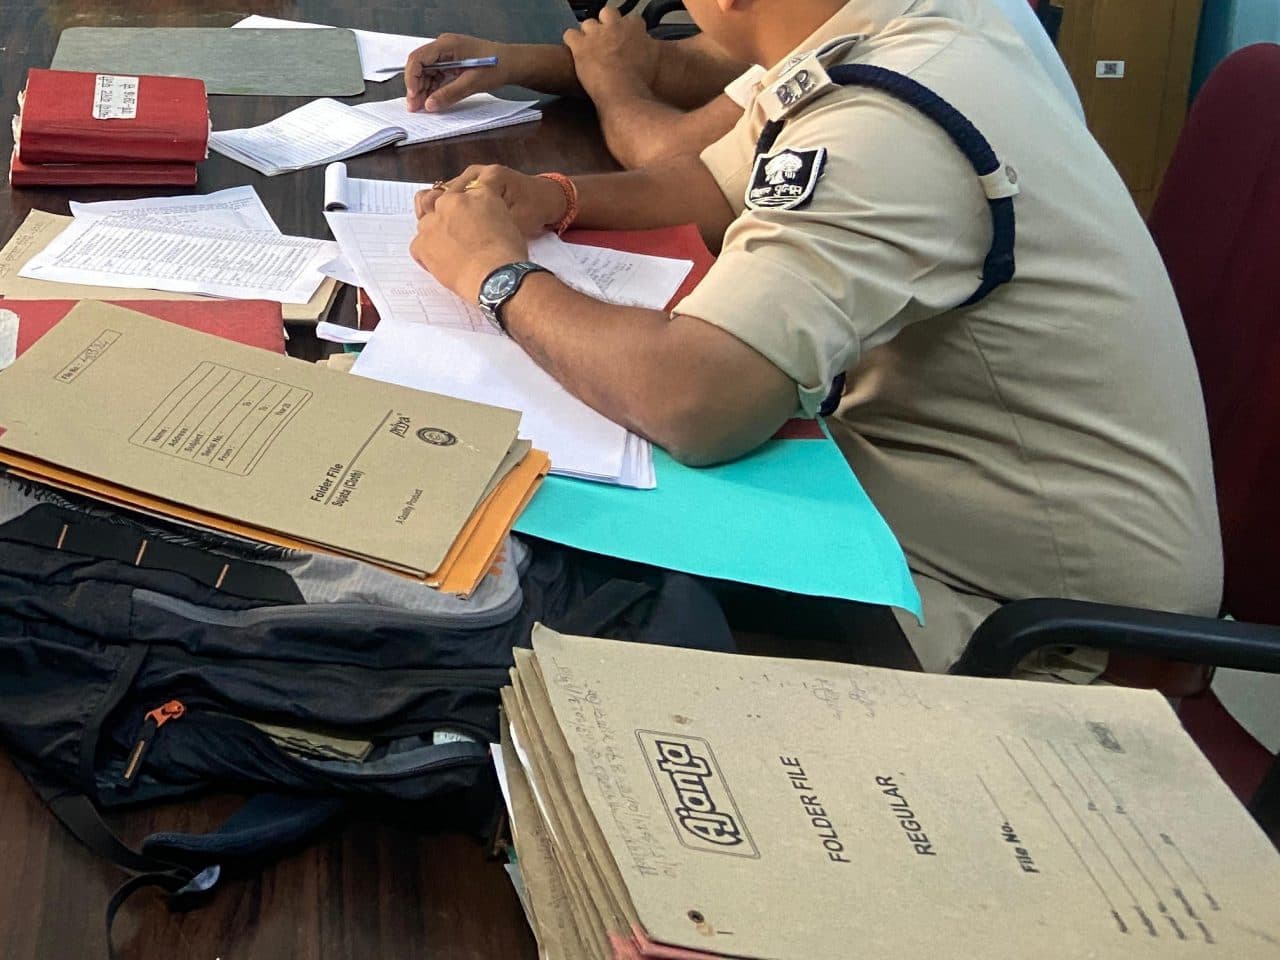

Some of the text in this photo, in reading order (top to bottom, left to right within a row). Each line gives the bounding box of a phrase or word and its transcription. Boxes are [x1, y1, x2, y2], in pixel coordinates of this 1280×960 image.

[310, 462, 344, 503] Folder File
[655, 739, 744, 847] Ajanta
[779, 755, 851, 864] FOLDER FILE
[875, 774, 937, 857] REGULAR
[999, 820, 1040, 874] File No.
